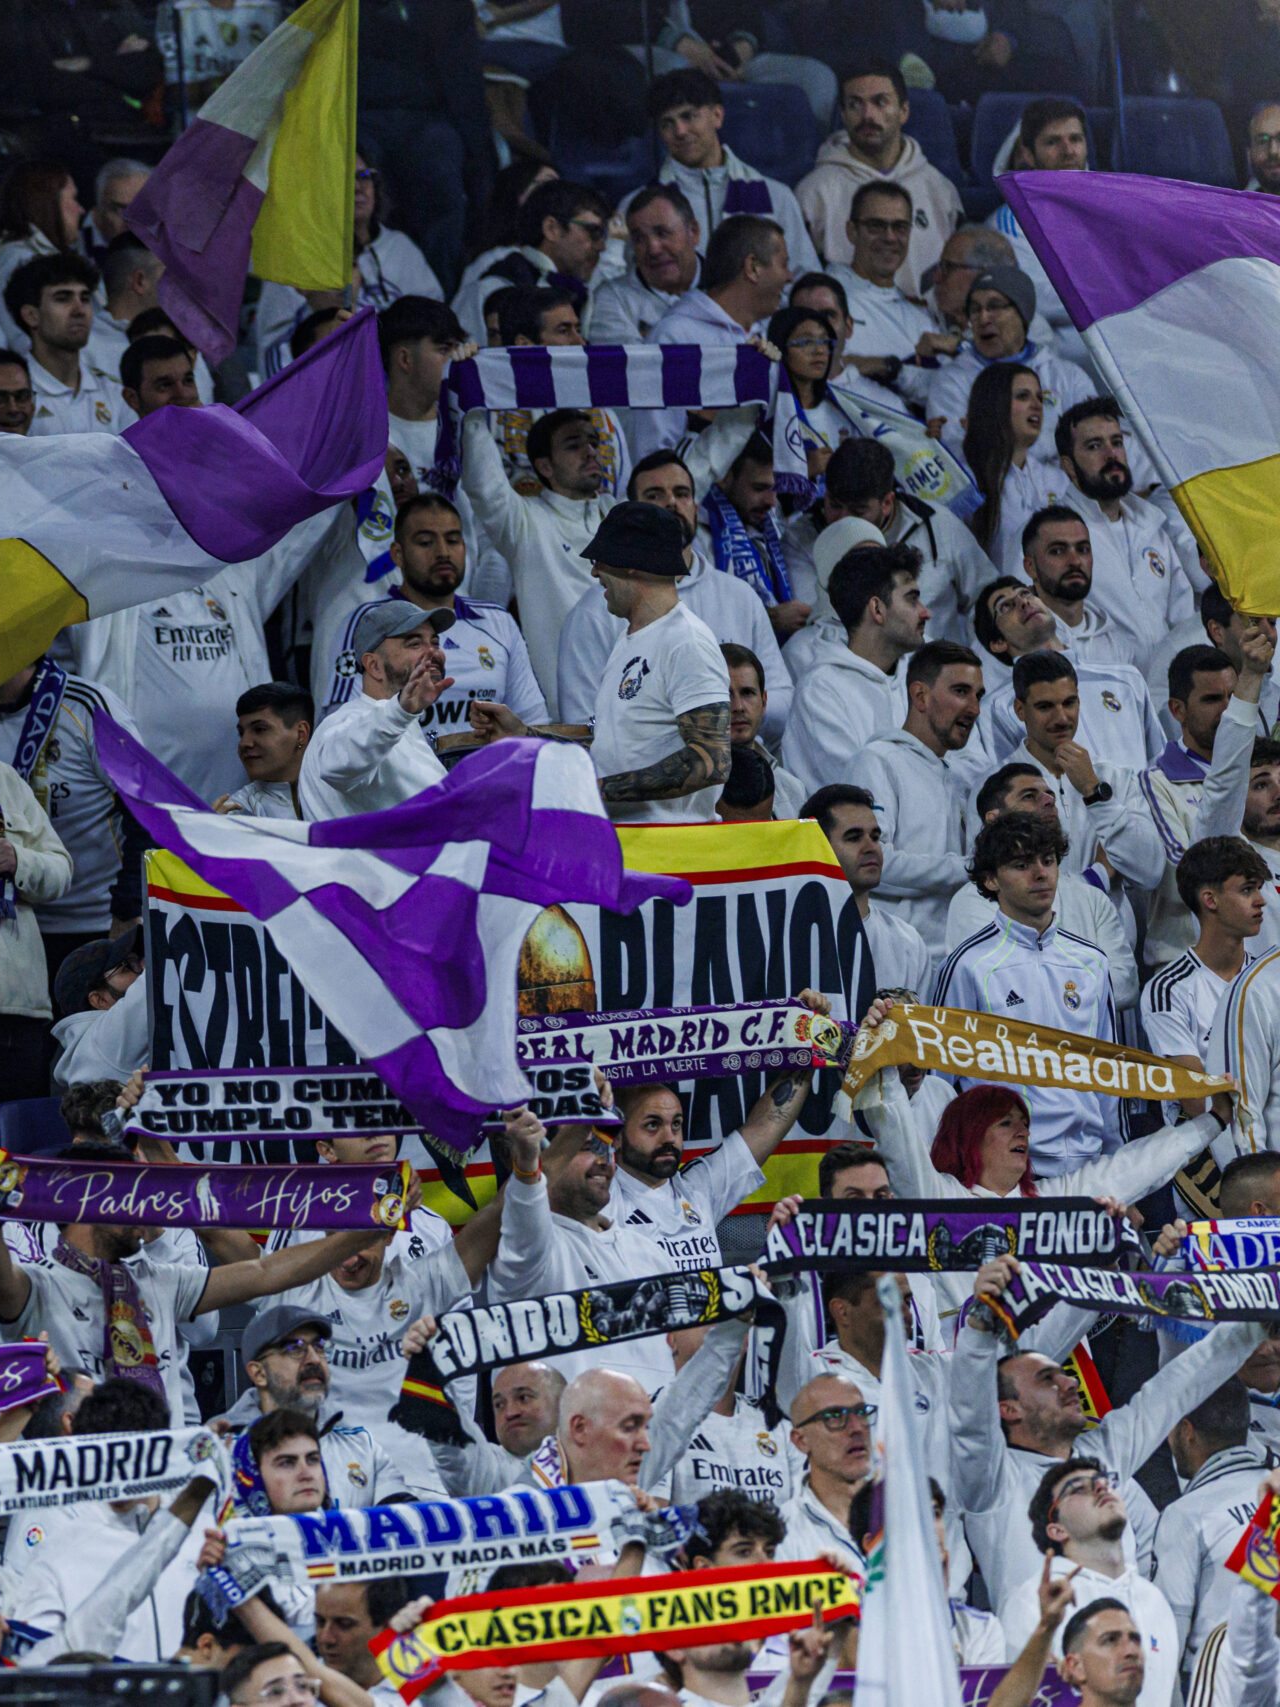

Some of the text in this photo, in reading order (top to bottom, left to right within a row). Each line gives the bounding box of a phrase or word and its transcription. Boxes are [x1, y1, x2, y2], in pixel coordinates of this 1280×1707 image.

[906, 456, 946, 493] RMCF
[586, 1009, 656, 1024] MADRIDISTA
[609, 1016, 730, 1061] MADRID
[740, 1010, 789, 1047] C.F.
[642, 1062, 658, 1076] LA
[664, 1058, 708, 1074] MUERTE
[907, 1019, 1176, 1094] Realmadrid
[154, 1082, 210, 1106] YO
[223, 1080, 281, 1105] NO
[141, 1106, 313, 1135] CUMPLO
[53, 1168, 191, 1223] Padres
[246, 1168, 360, 1230] Hijos
[796, 1212, 926, 1256] CLASICA
[1019, 1211, 1115, 1255] FONDO
[1046, 1264, 1145, 1307] CLASICA
[1192, 1272, 1279, 1310] FONDO
[12, 1436, 174, 1494] MADRID
[692, 1458, 784, 1488] Emirates
[290, 1484, 597, 1560] MADRID
[339, 1554, 426, 1578] MADRID
[432, 1552, 444, 1567] Y
[452, 1545, 514, 1566] NADA
[519, 1537, 567, 1559] MÁS
[436, 1576, 847, 1652] CLÁSICA FANS RMCF
